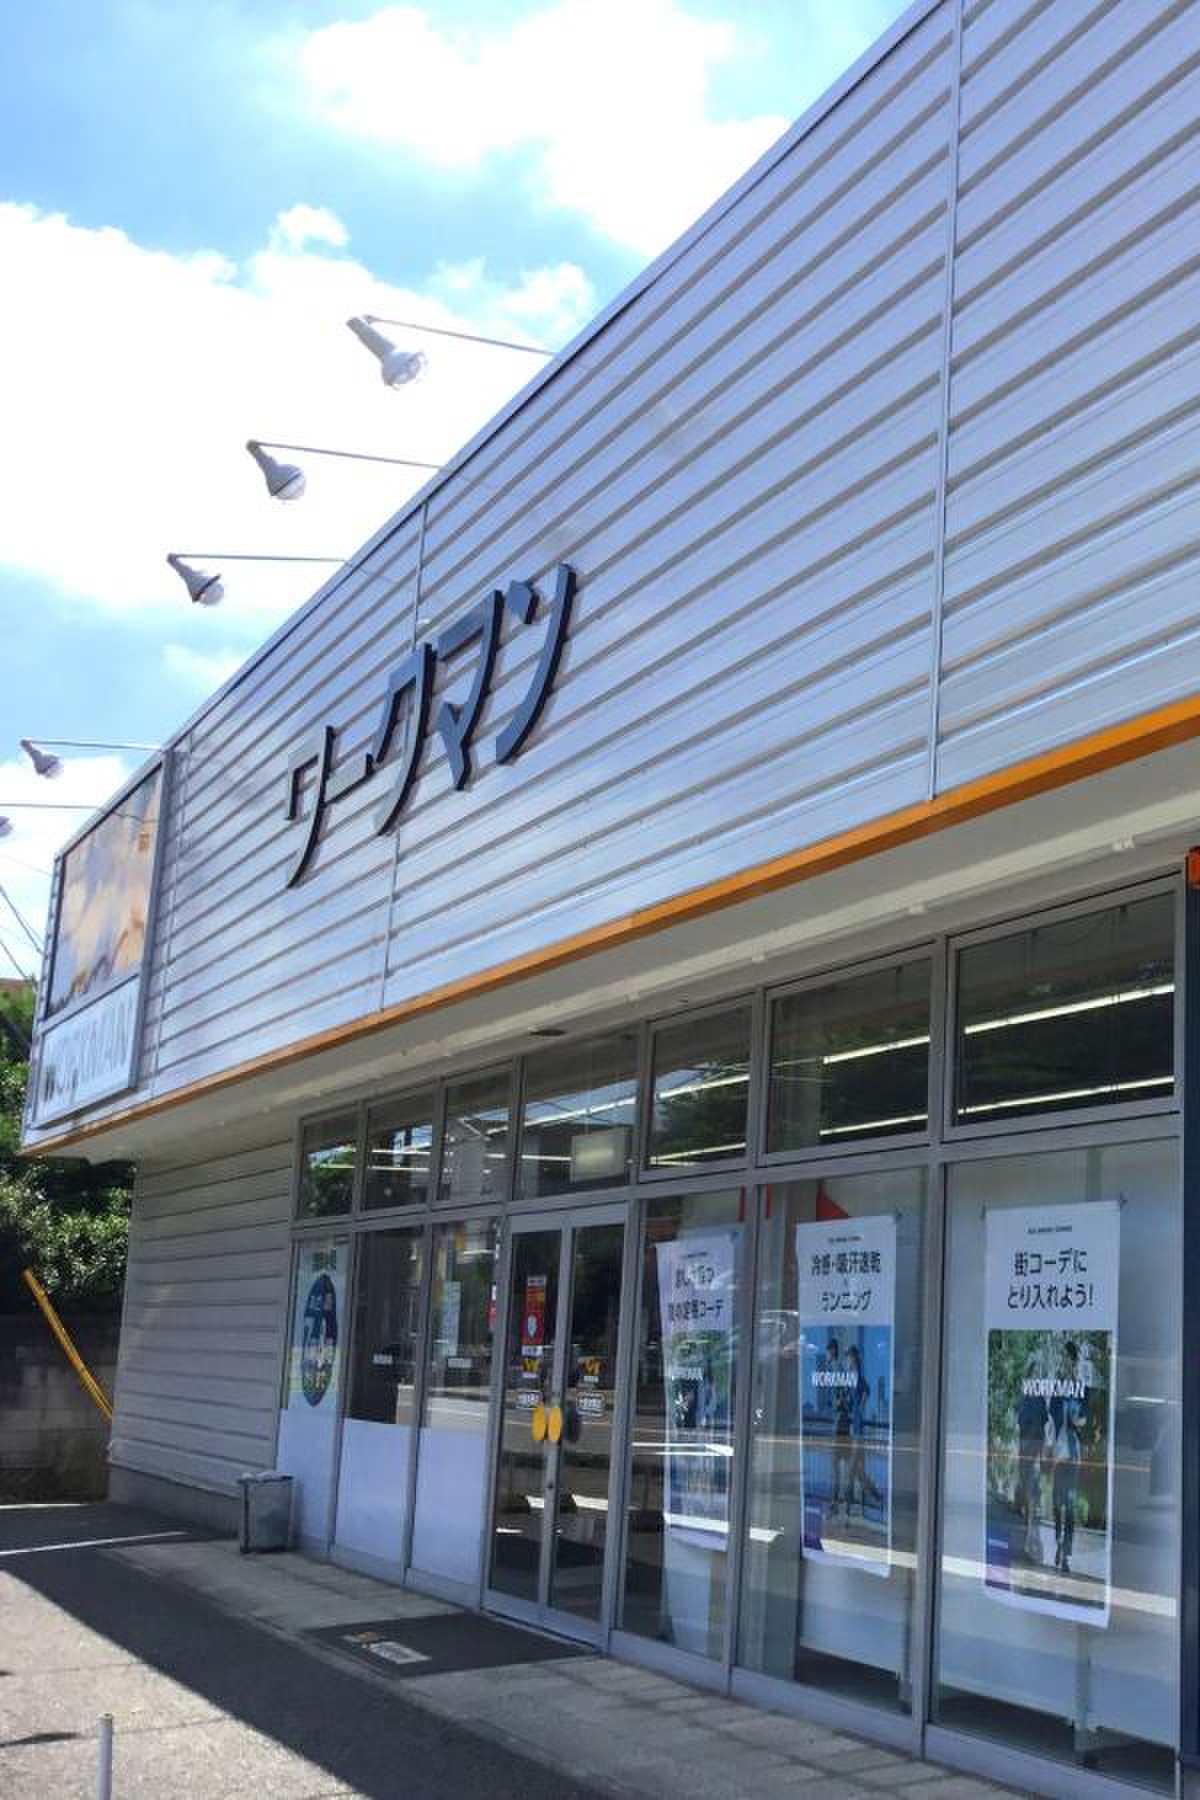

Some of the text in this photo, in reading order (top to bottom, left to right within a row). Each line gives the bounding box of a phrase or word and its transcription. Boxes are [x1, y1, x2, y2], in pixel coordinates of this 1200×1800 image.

[287, 563, 577, 888] ワークマン
[1014, 1248, 1087, 1276] 街コーデに
[821, 1289, 872, 1312] ランニング
[811, 1371, 859, 1388] WORKMAN
[1023, 1378, 1085, 1398] WORKMAN
